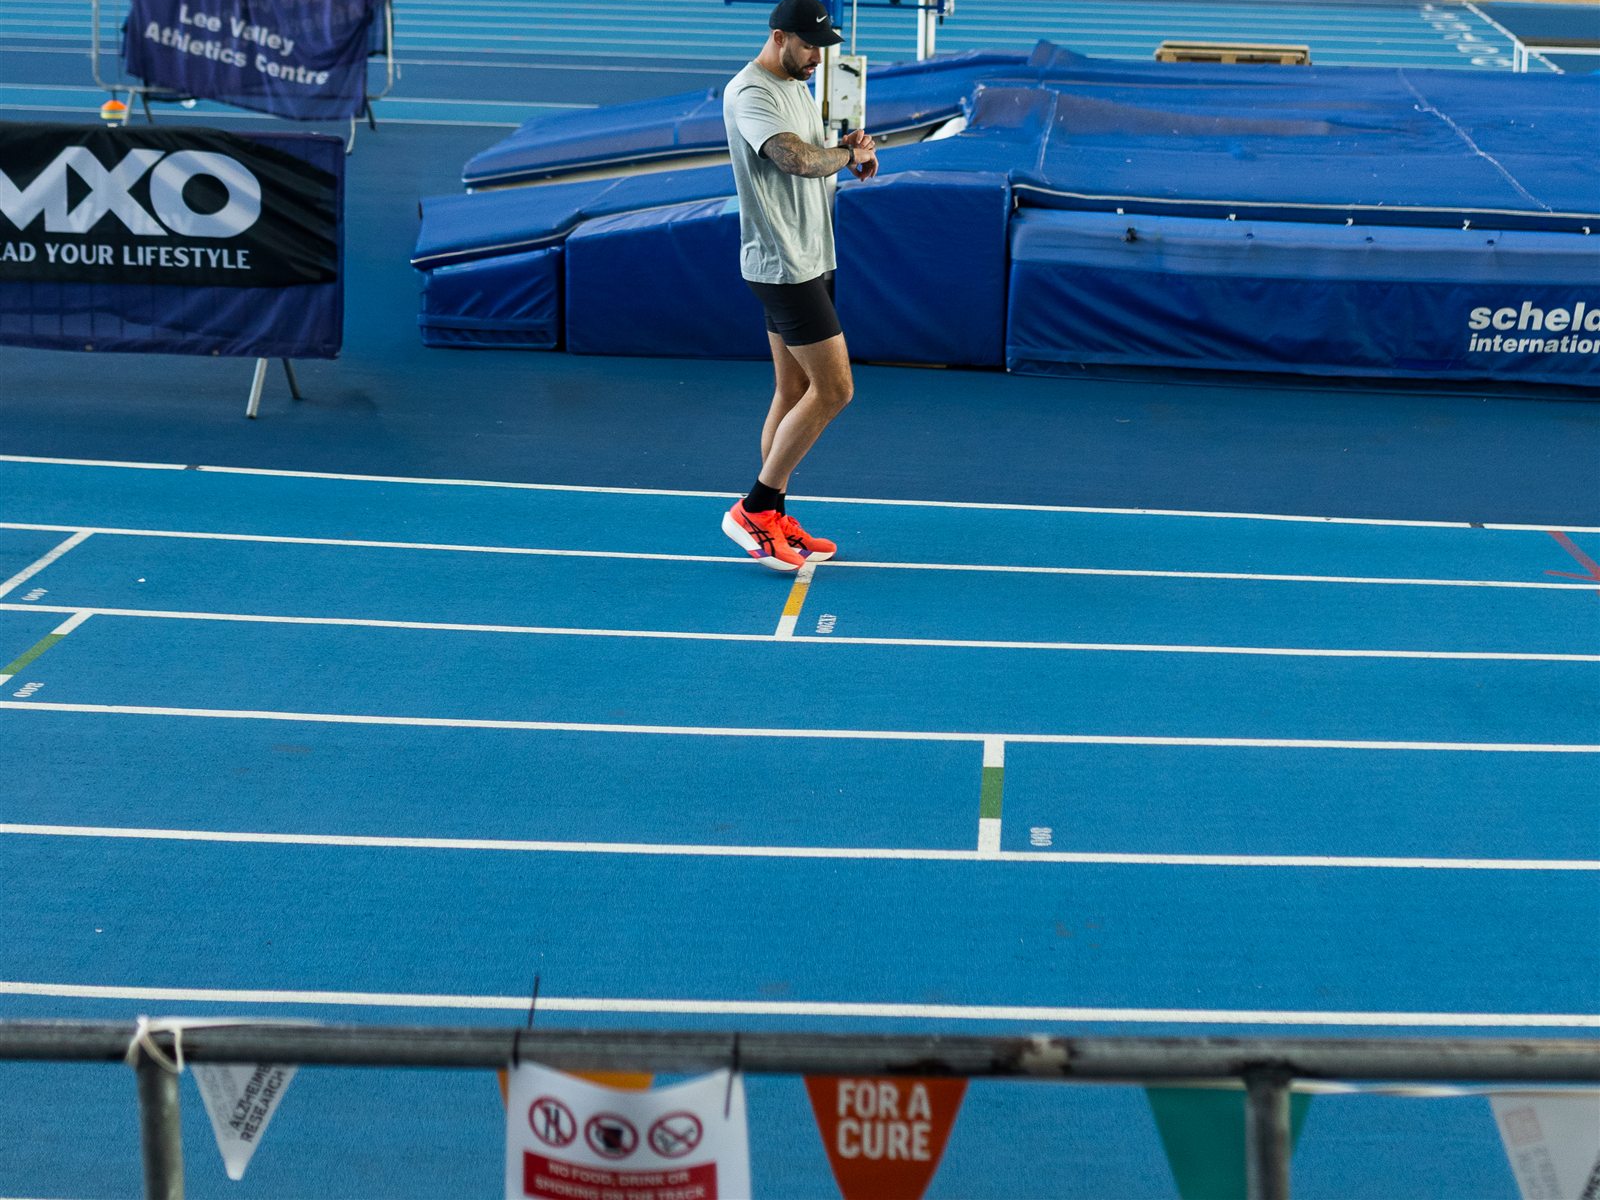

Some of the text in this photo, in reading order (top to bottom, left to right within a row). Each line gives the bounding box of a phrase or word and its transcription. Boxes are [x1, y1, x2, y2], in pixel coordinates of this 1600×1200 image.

[144, 21, 247, 67] Athletics
[179, 4, 221, 32] Lee
[230, 15, 294, 57] Valley
[0, 241, 251, 269] AD YOUR LIFESTYLE
[239, 1070, 285, 1142] RESEARCH
[837, 1080, 932, 1120] FOR A
[837, 1118, 932, 1161] CURE
[535, 1176, 706, 1200] SMOKING ON THE TRACK
[549, 1163, 569, 1177] NO
[619, 1173, 665, 1186] DRINK
[668, 1171, 689, 1185] OR
